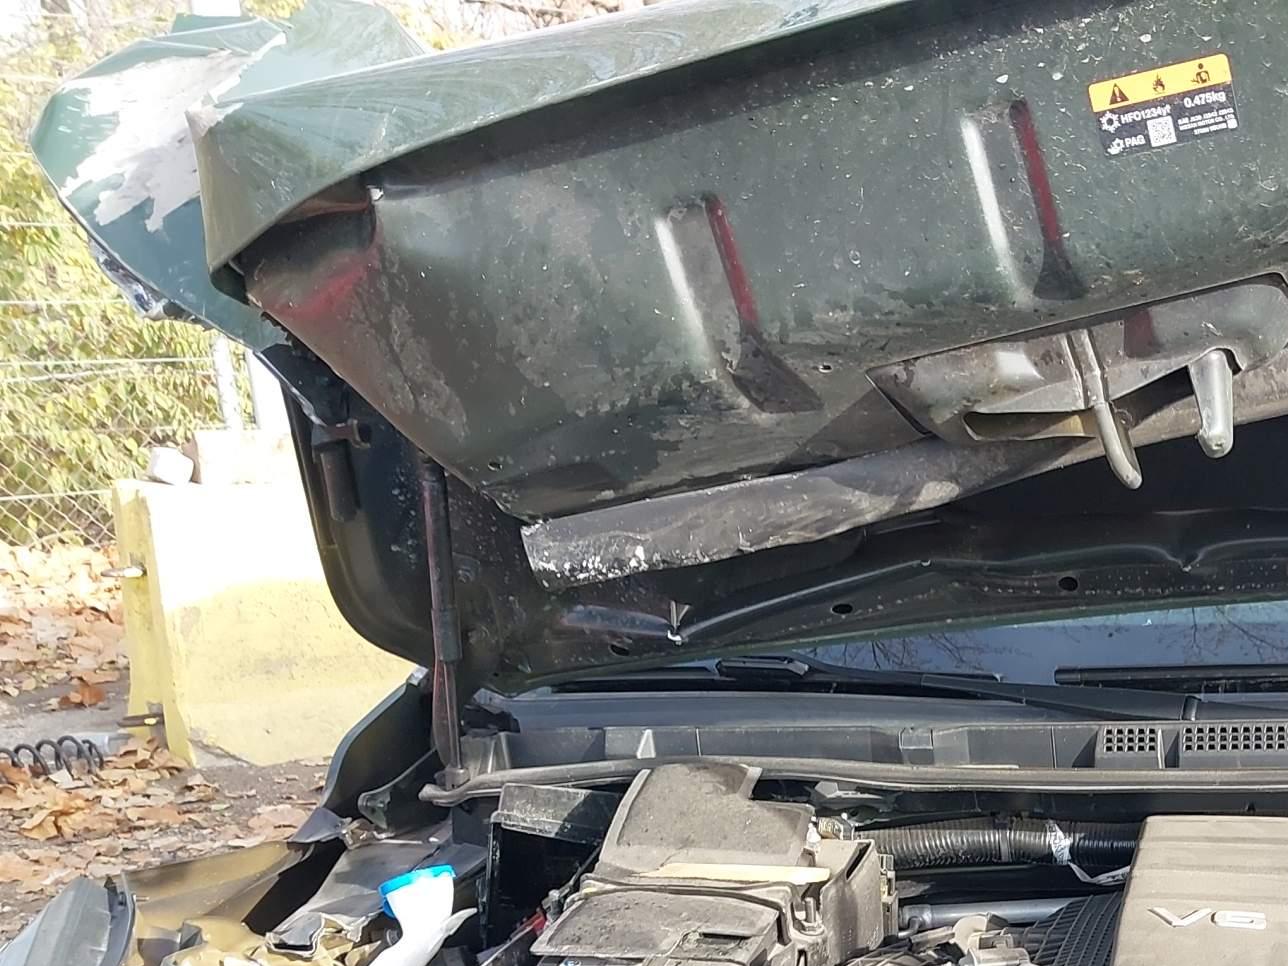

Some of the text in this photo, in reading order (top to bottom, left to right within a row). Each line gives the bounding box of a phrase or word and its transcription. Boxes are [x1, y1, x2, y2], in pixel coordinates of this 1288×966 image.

[1183, 91, 1226, 108] 0.475kg
[1124, 134, 1146, 148] PAG
[1147, 906, 1267, 930] V6
